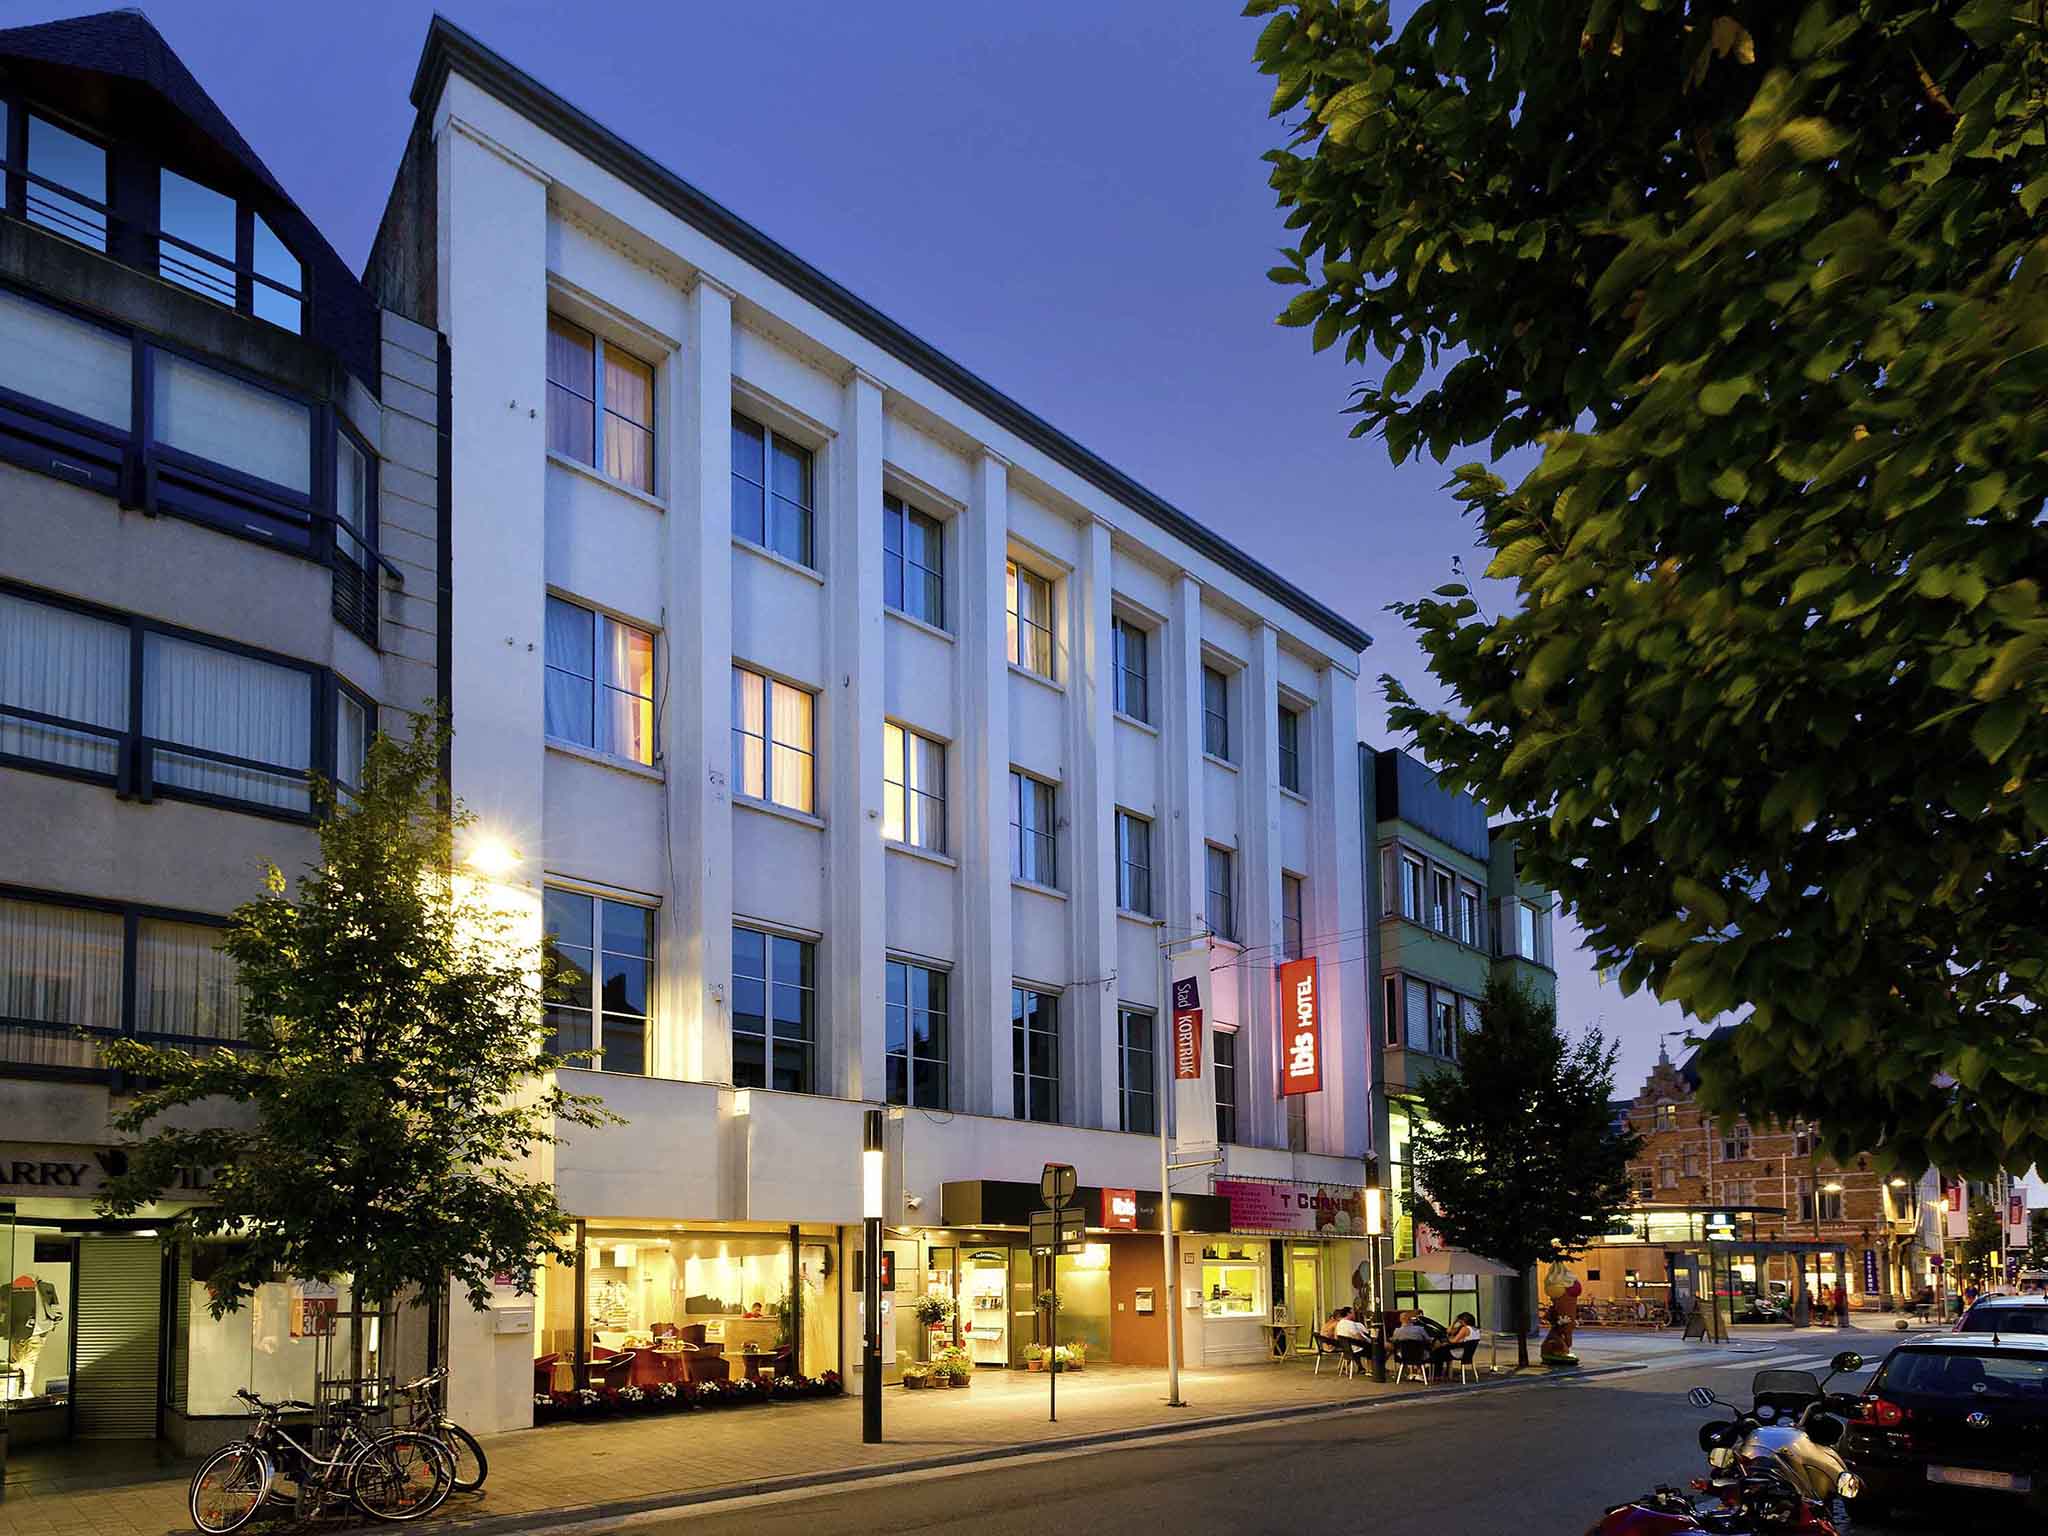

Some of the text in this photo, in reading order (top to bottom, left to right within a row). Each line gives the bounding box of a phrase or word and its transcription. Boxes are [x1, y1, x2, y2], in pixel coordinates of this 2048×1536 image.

[1177, 983, 1192, 1008] Stad
[1297, 975, 1312, 1028] HOTEL
[1178, 1015, 1194, 1073] KORTRIJK
